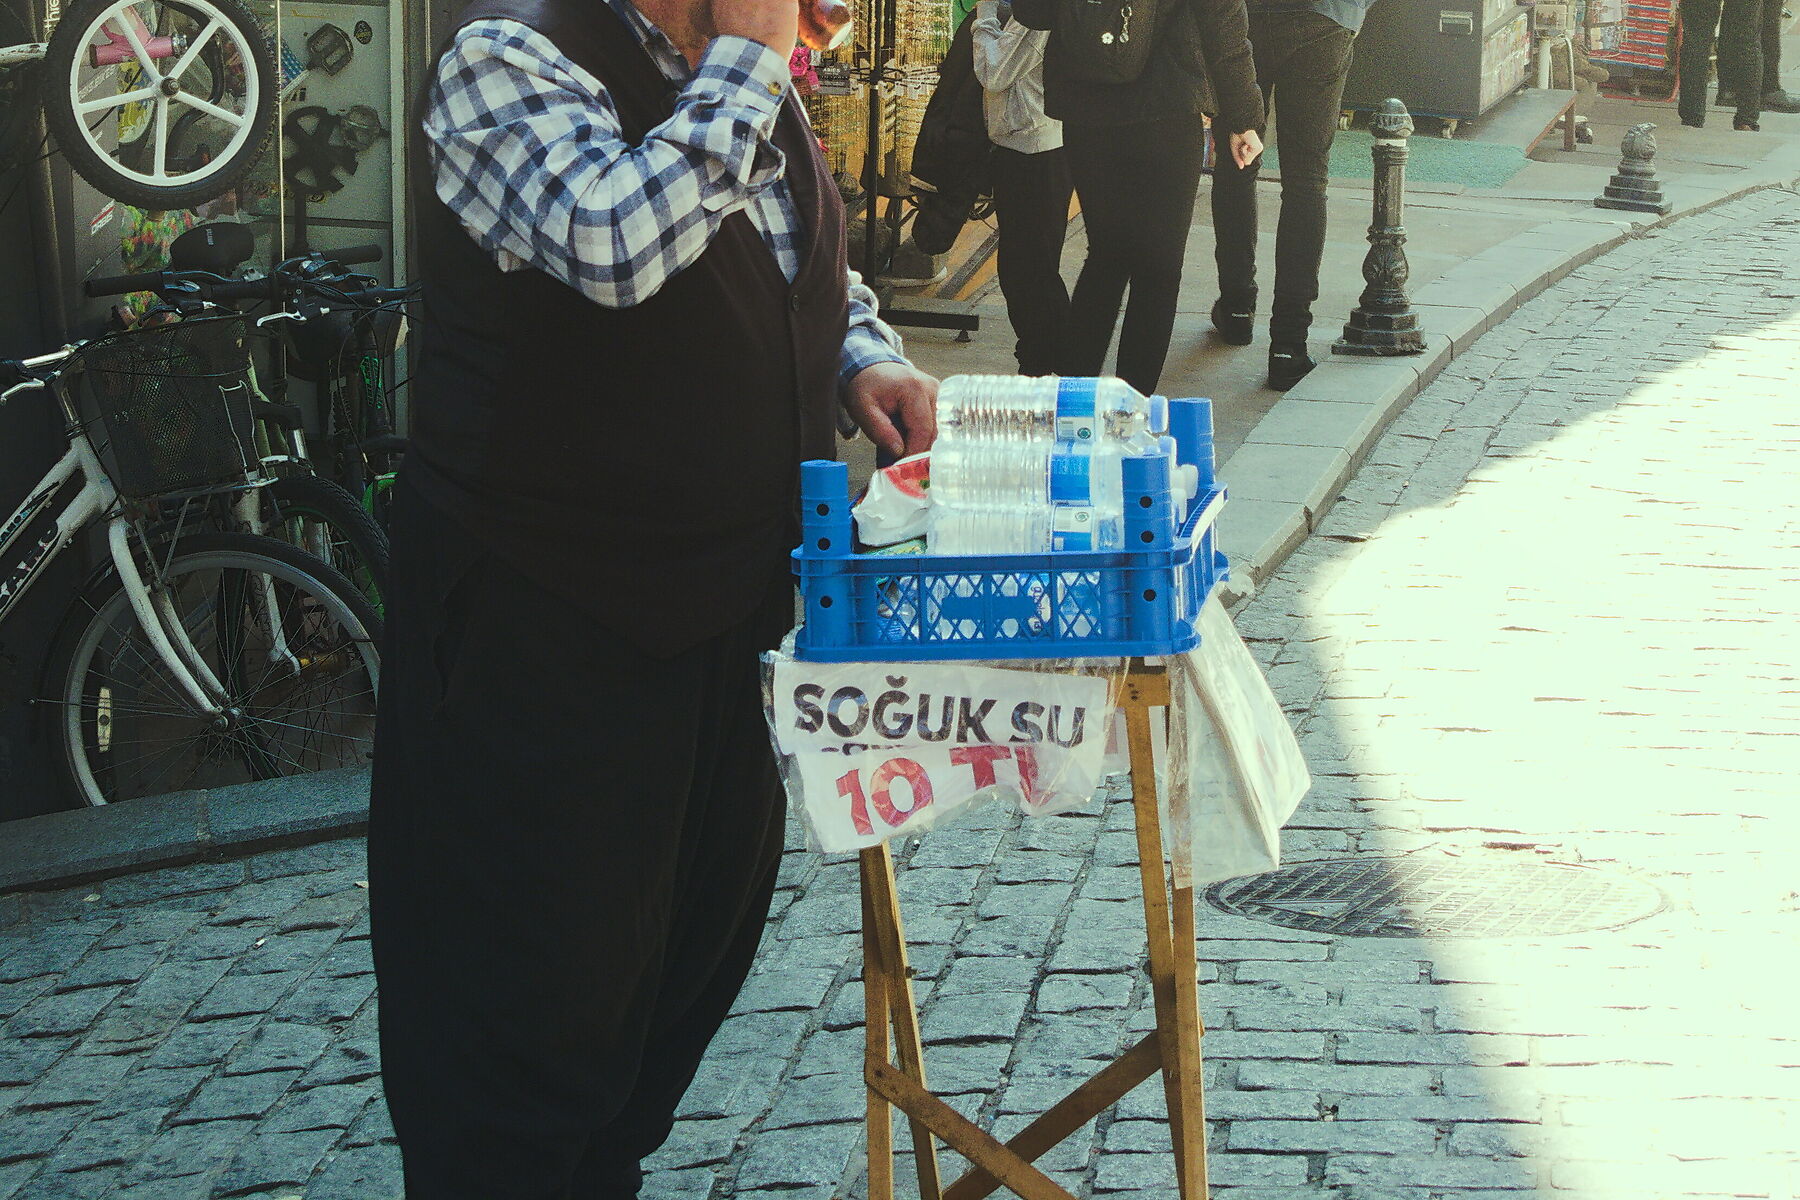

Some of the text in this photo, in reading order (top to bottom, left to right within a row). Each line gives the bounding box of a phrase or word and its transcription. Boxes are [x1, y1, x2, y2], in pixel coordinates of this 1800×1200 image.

[793, 675, 1087, 749] SOĞUK SU
[835, 757, 934, 836] 10
